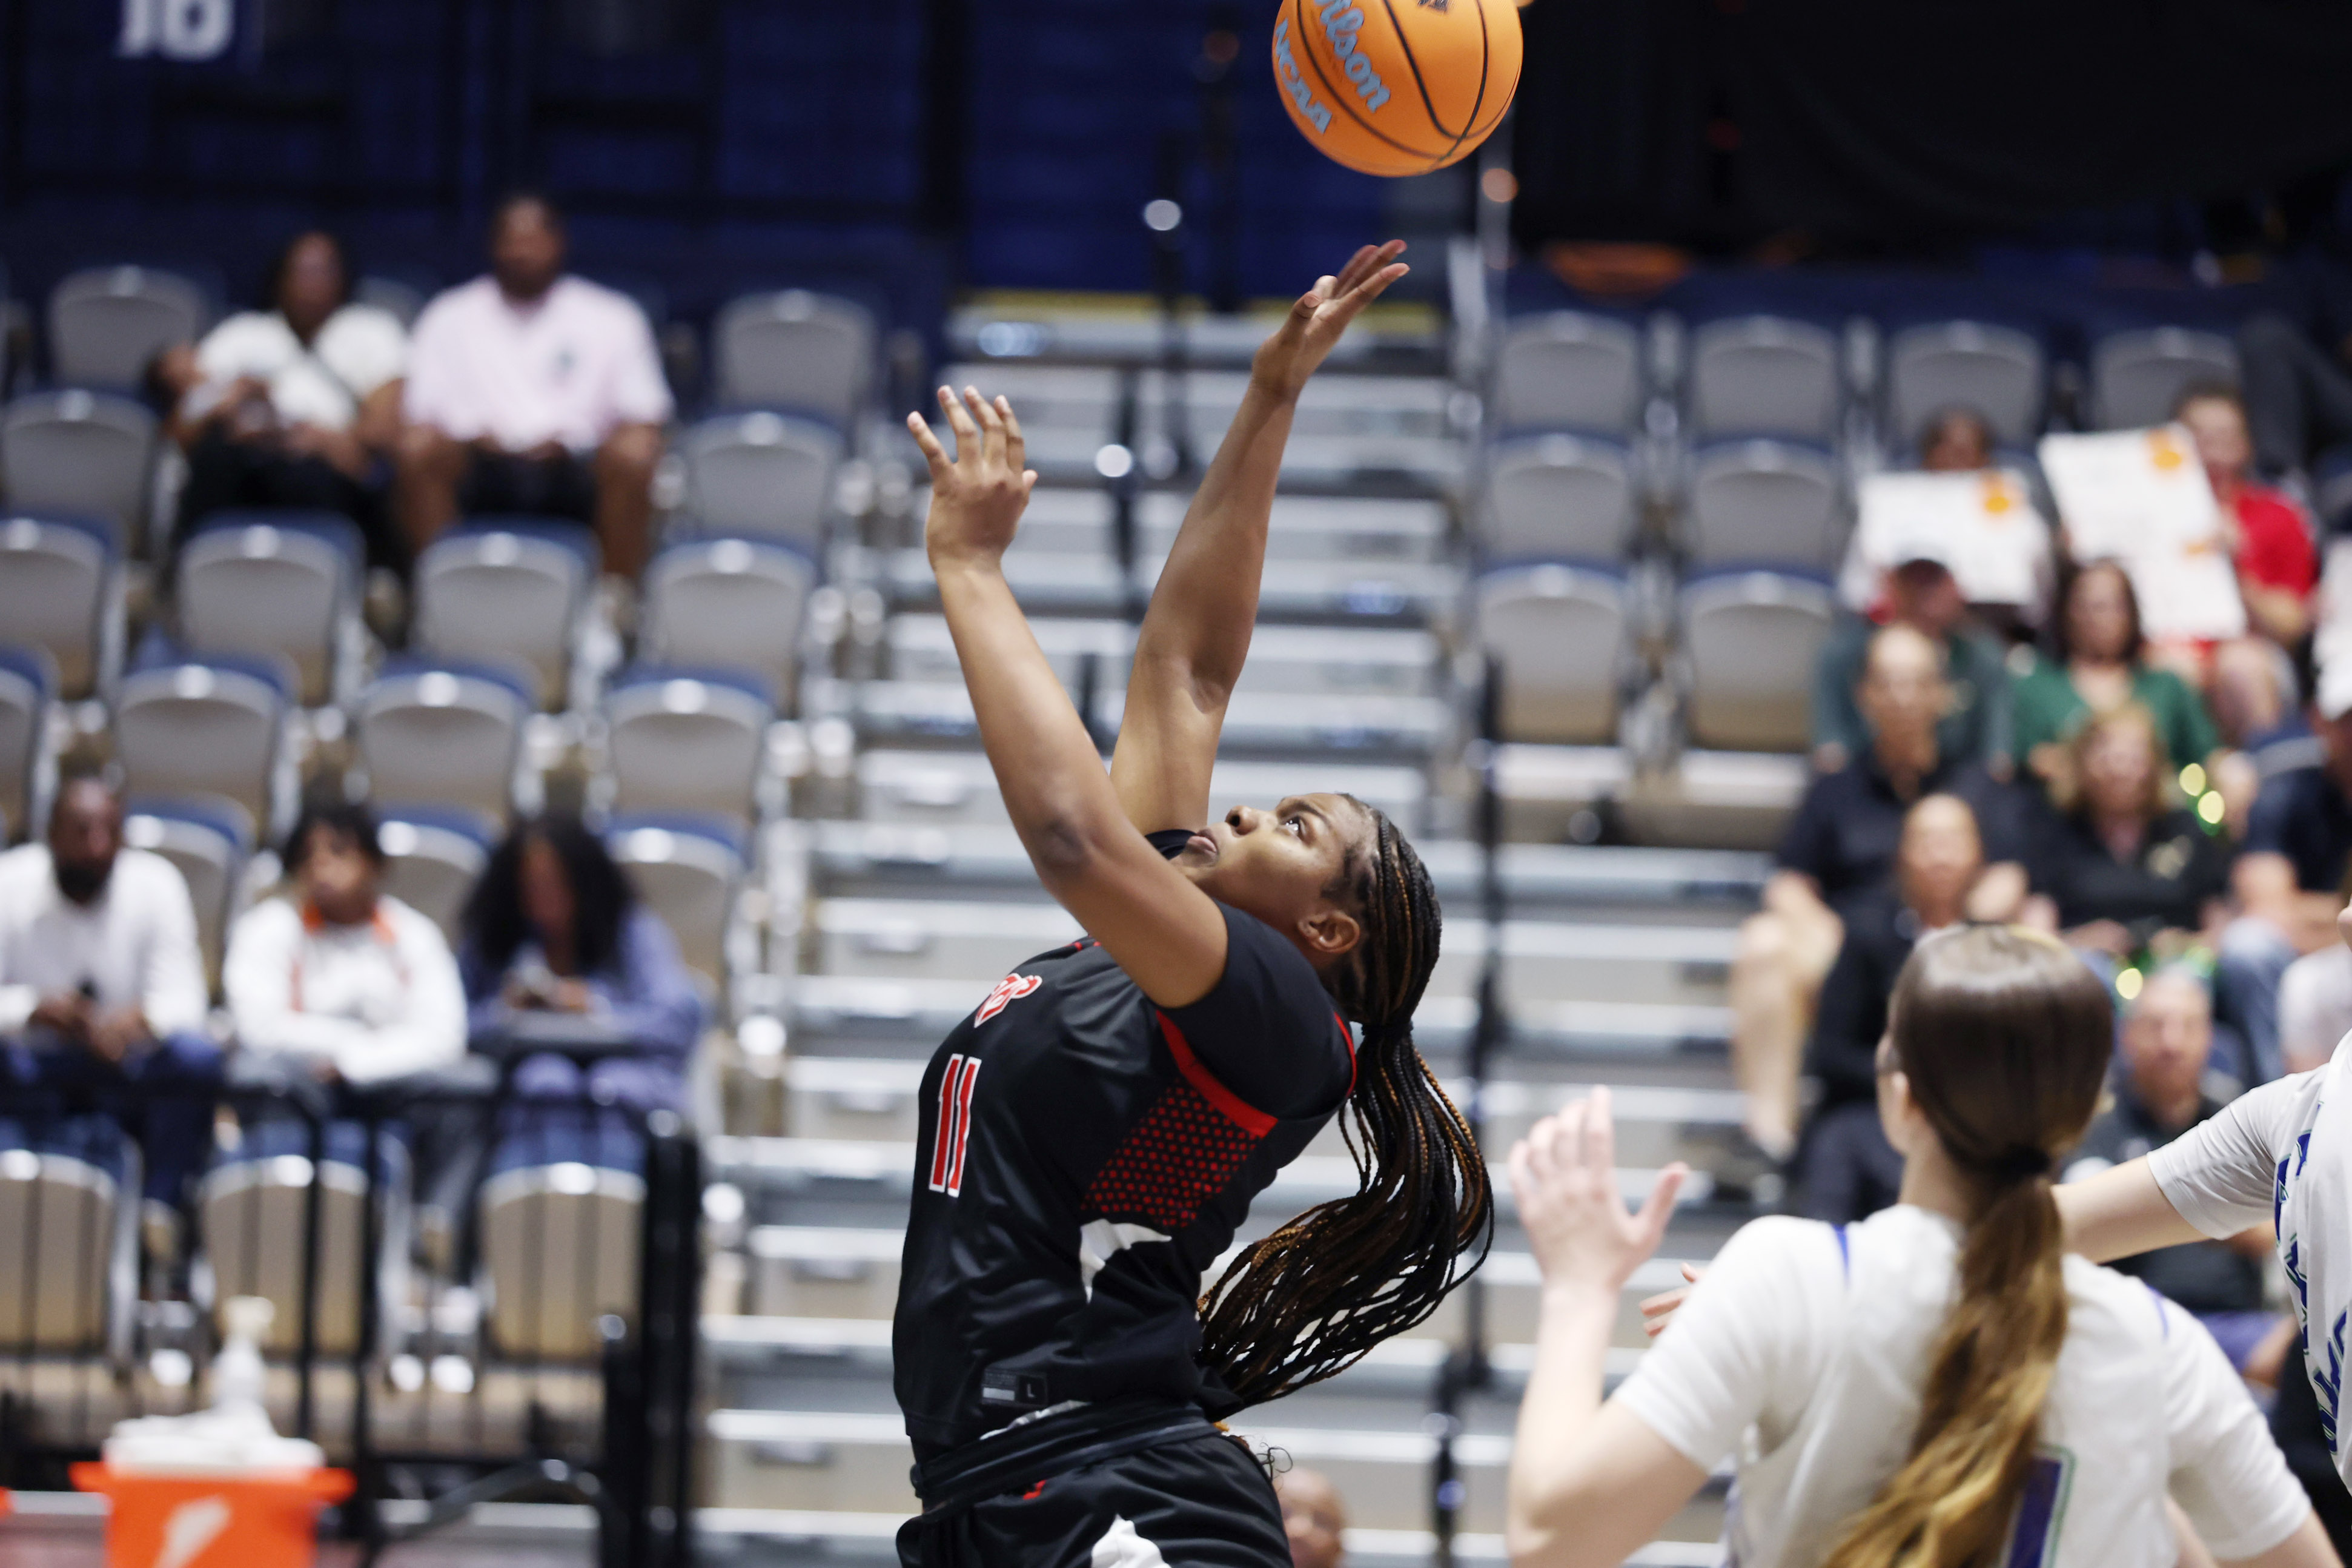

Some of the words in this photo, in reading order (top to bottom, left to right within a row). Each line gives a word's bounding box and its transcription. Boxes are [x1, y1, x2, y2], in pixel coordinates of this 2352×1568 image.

[1275, 18, 1333, 134] NCAA
[1313, 0, 1391, 114] ilson
[929, 1053, 982, 1199] 11
[1026, 1383, 1035, 1398] L
